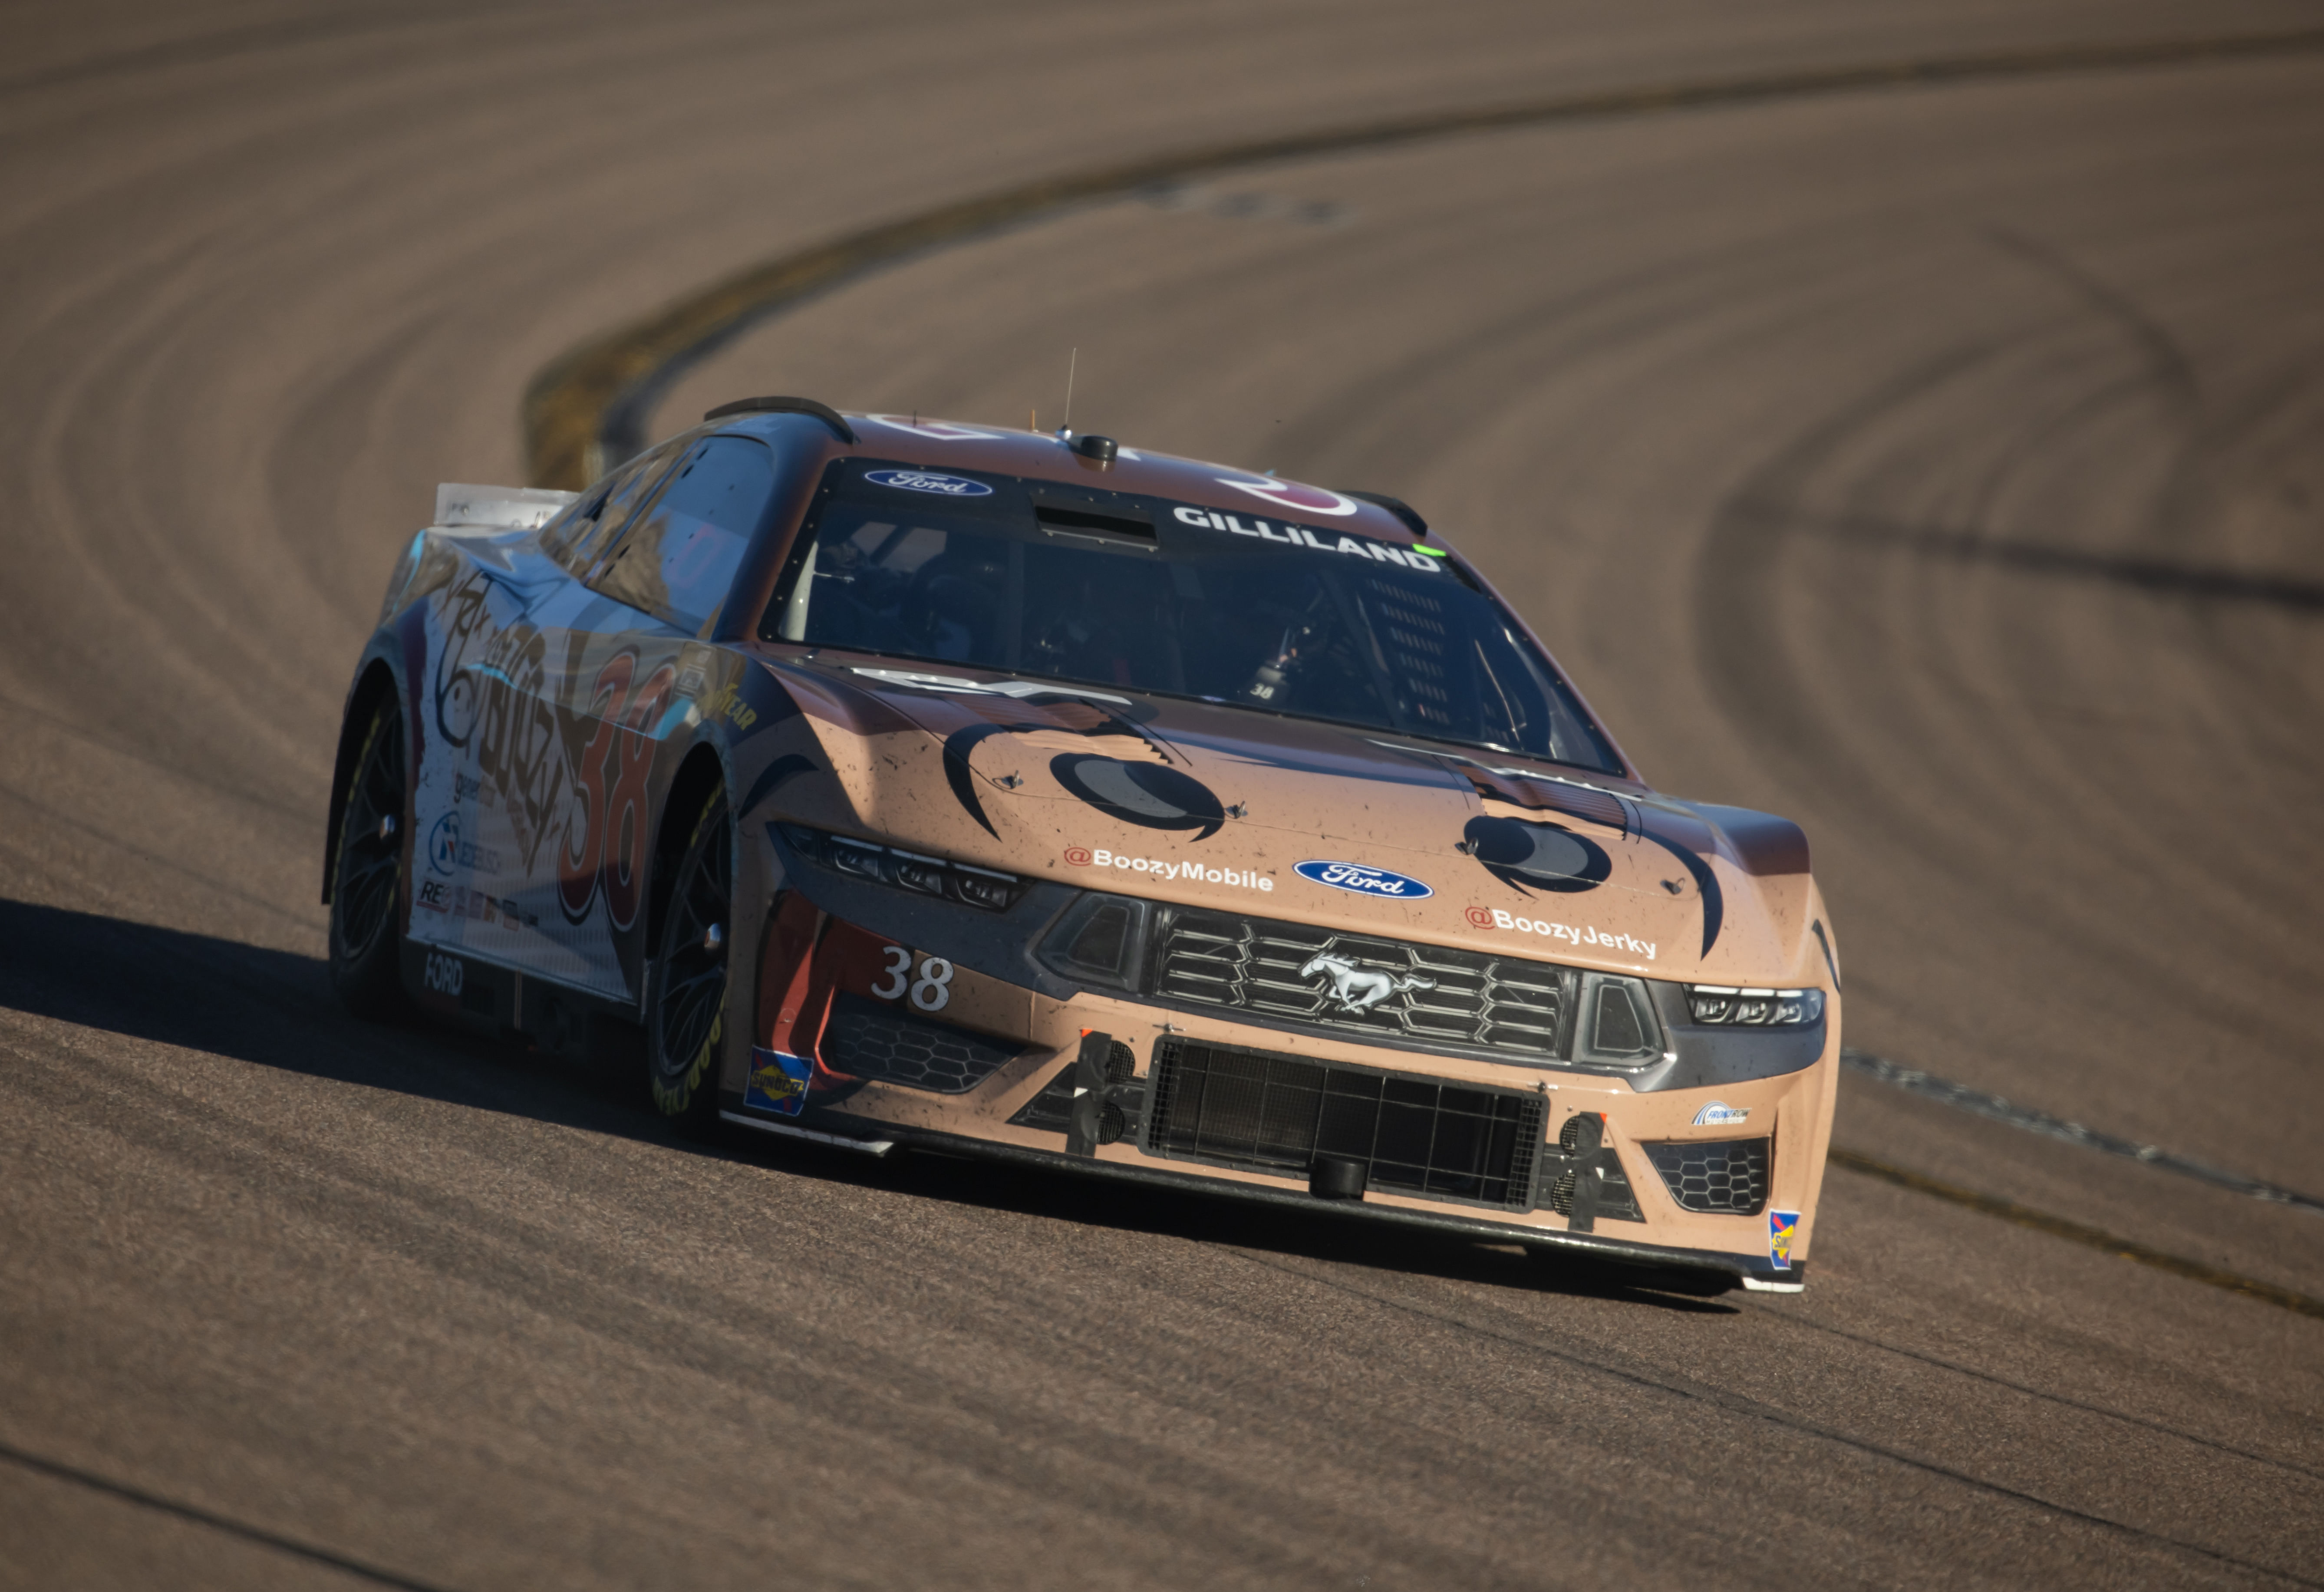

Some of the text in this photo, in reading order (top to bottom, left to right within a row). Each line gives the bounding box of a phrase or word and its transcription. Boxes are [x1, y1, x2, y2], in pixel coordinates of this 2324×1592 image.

[888, 472, 969, 493] Ford
[1174, 507, 1441, 572] GILLILAND
[557, 647, 676, 933] 38
[1065, 847, 1274, 892] @BoozyMobile
[1321, 864, 1405, 894] Ford
[1465, 906, 1656, 960] @BoozyJerky
[424, 952, 463, 996] FORD
[870, 946, 955, 1012] 38
[751, 1072, 798, 1094] SUNOCO
